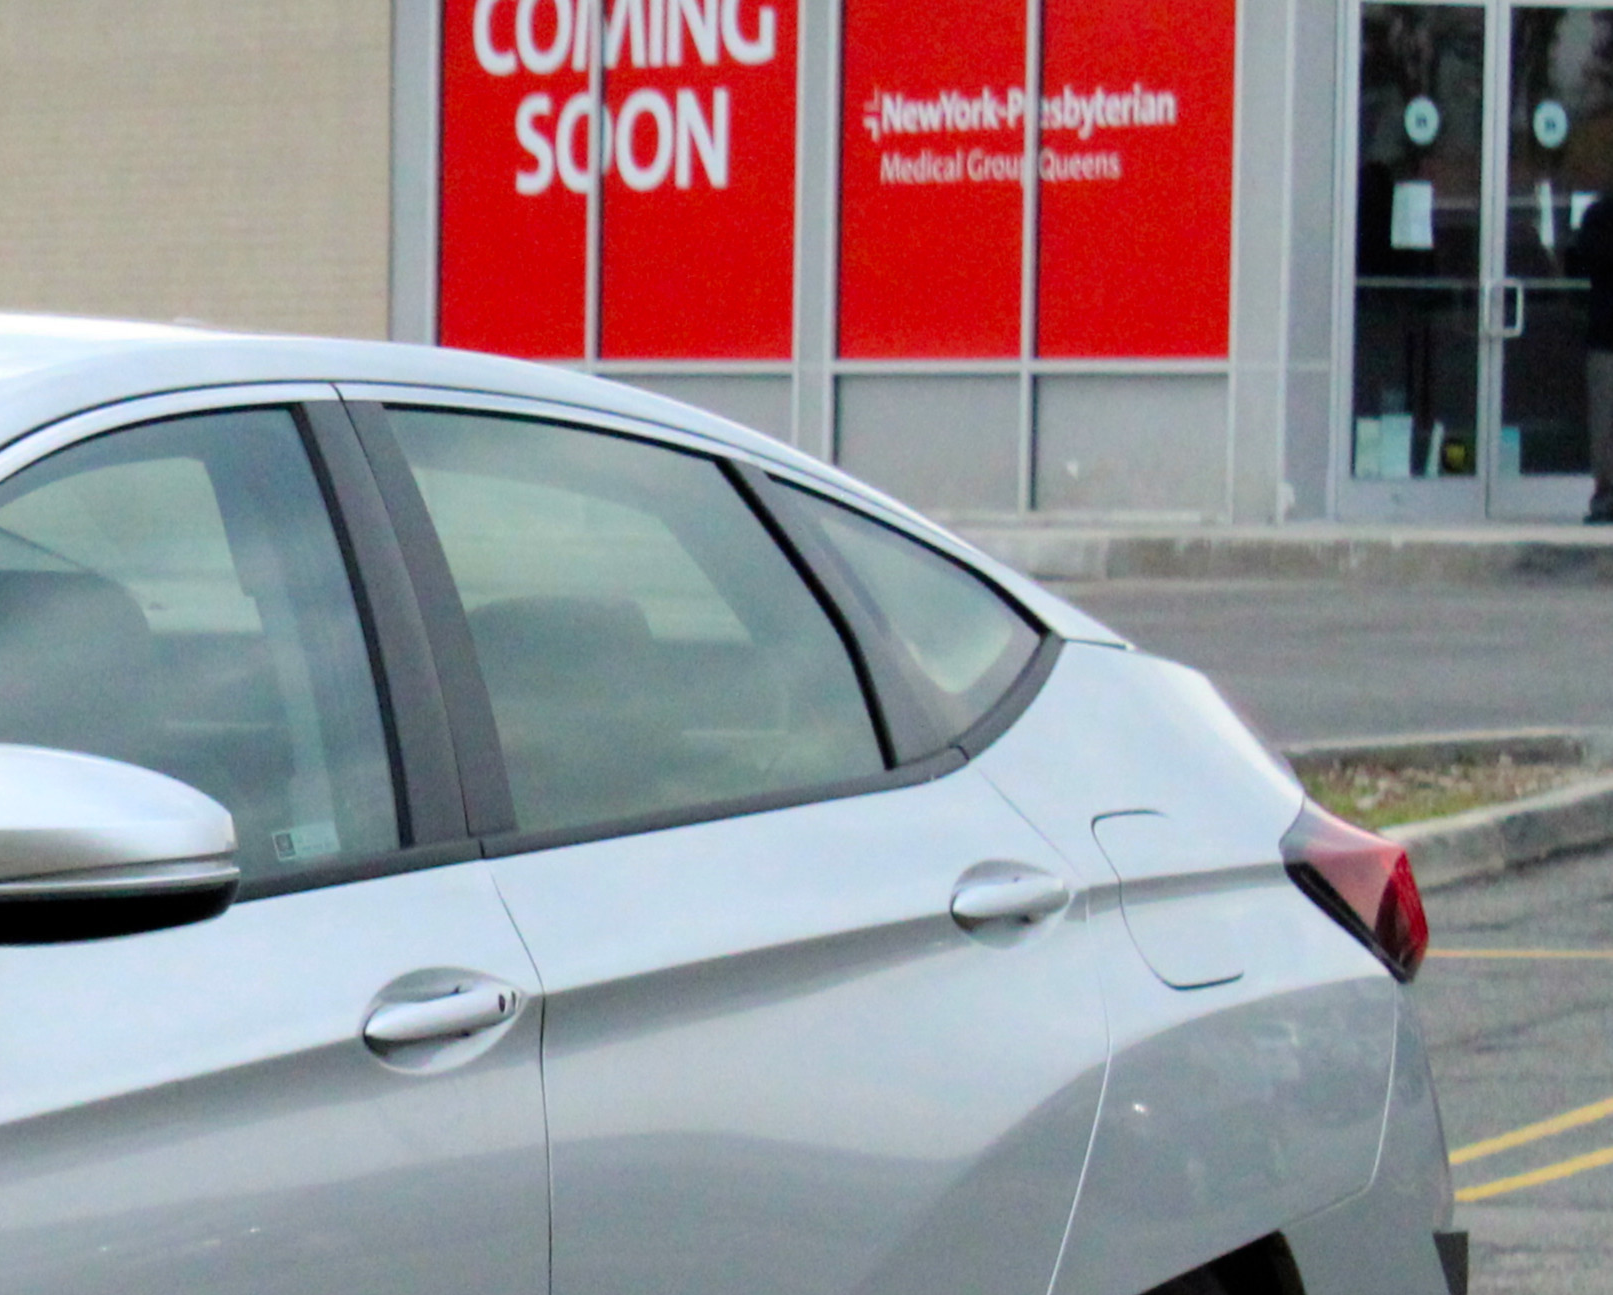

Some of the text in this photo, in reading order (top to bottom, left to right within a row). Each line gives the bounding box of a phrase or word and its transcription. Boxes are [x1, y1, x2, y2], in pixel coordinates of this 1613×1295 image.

[473, 0, 775, 76] COMING
[515, 87, 729, 195] SOON
[880, 148, 963, 183] Medical
[1039, 147, 1120, 183] Queens
